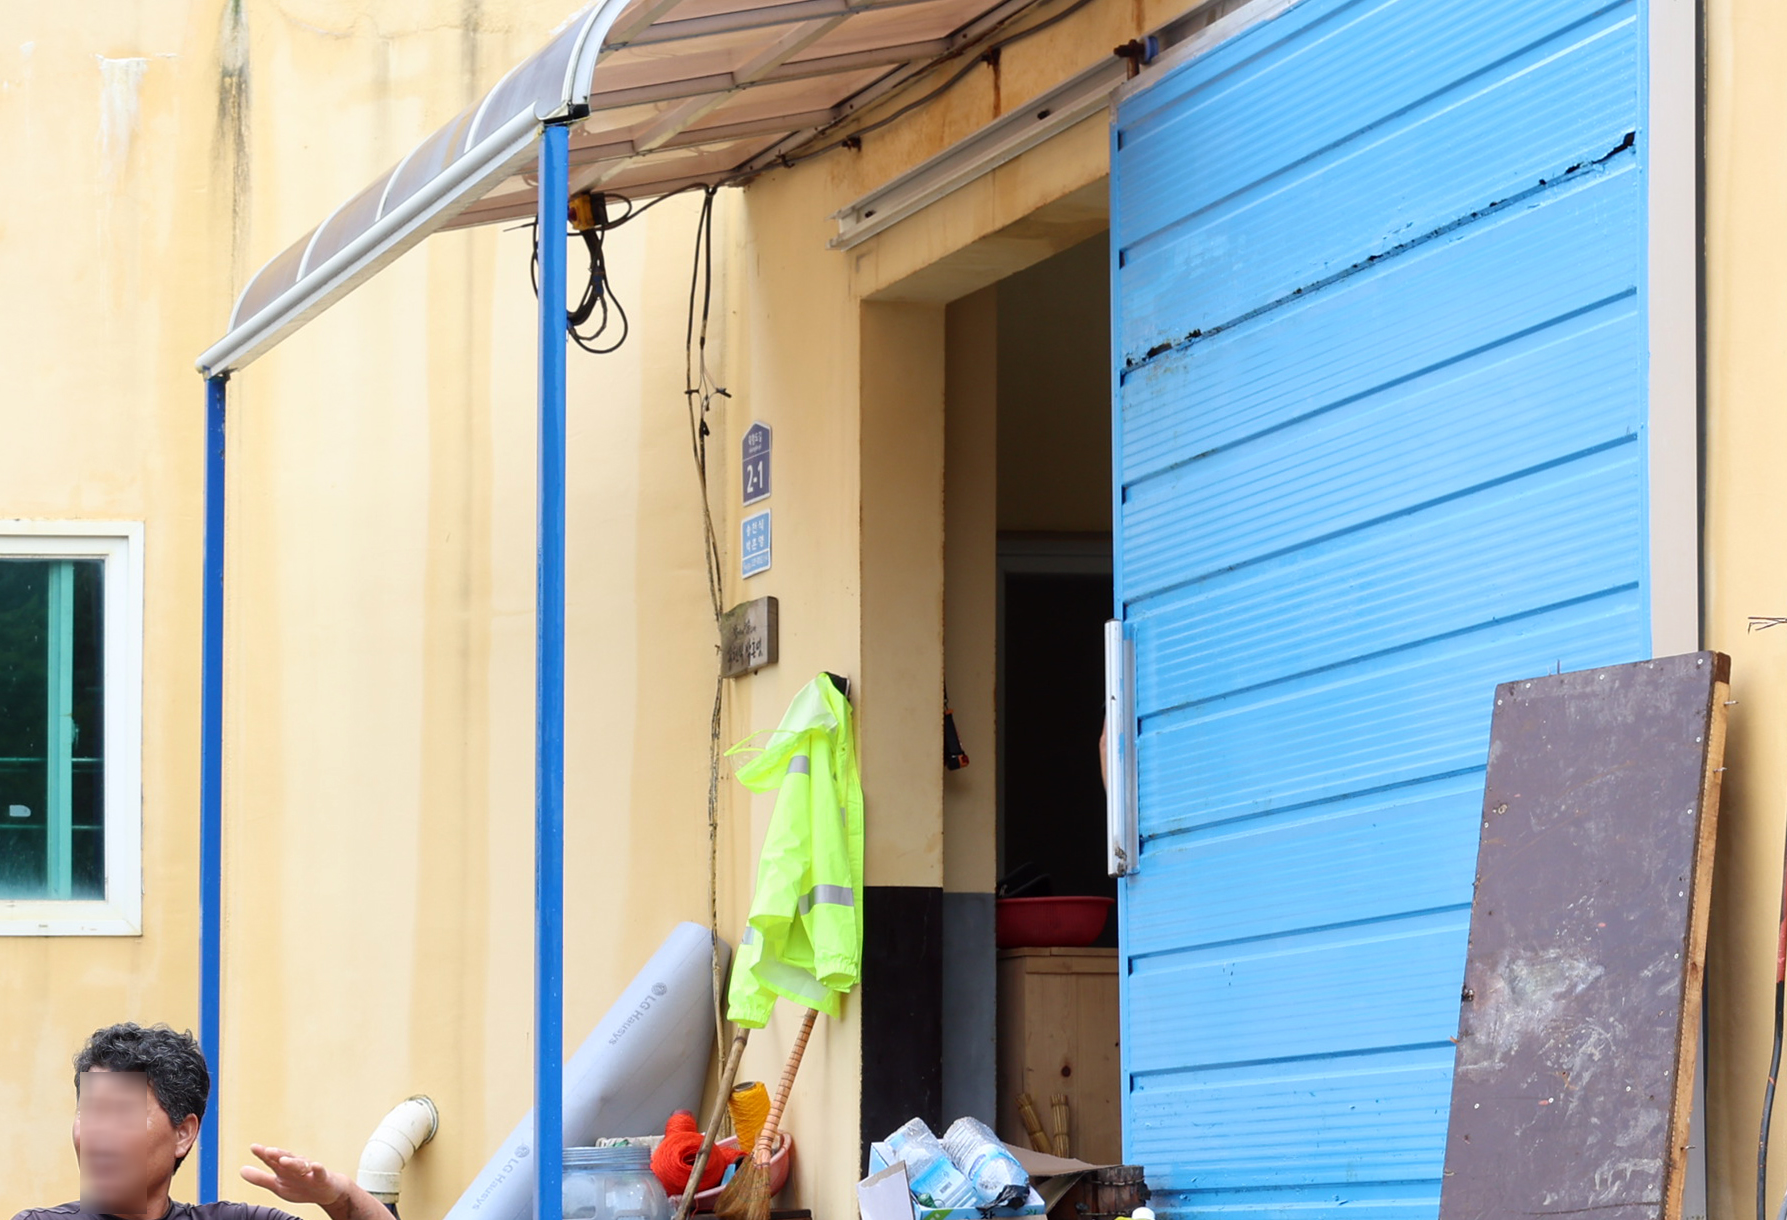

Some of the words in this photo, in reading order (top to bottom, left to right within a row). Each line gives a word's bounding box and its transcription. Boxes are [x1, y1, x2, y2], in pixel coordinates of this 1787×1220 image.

[746, 460, 763, 494] 2-1
[639, 995, 657, 1011] LG
[608, 1009, 645, 1045] Hausys
[502, 1158, 519, 1174] LG
[472, 1173, 506, 1210] Hausys
